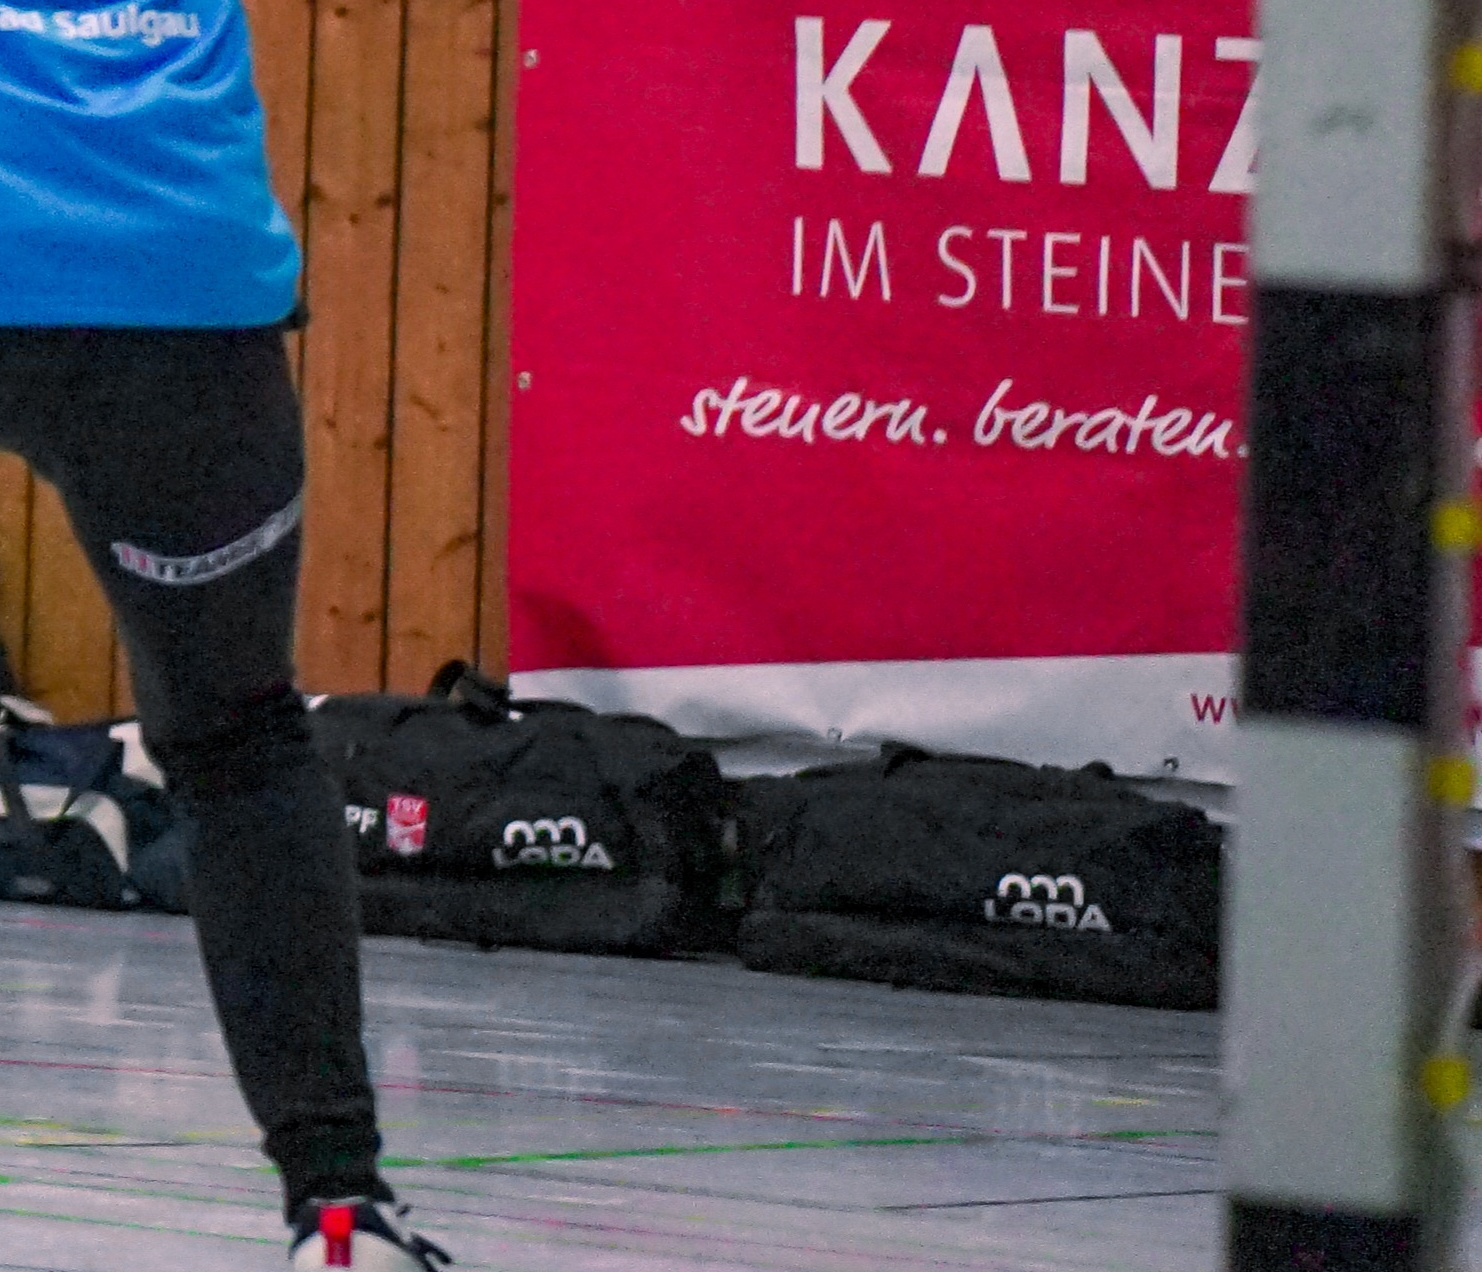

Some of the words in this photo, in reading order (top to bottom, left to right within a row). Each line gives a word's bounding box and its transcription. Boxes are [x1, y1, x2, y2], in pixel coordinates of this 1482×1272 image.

[790, 216, 893, 302] IM
[679, 376, 949, 445] steuern.
[973, 377, 1249, 460] beraten.
